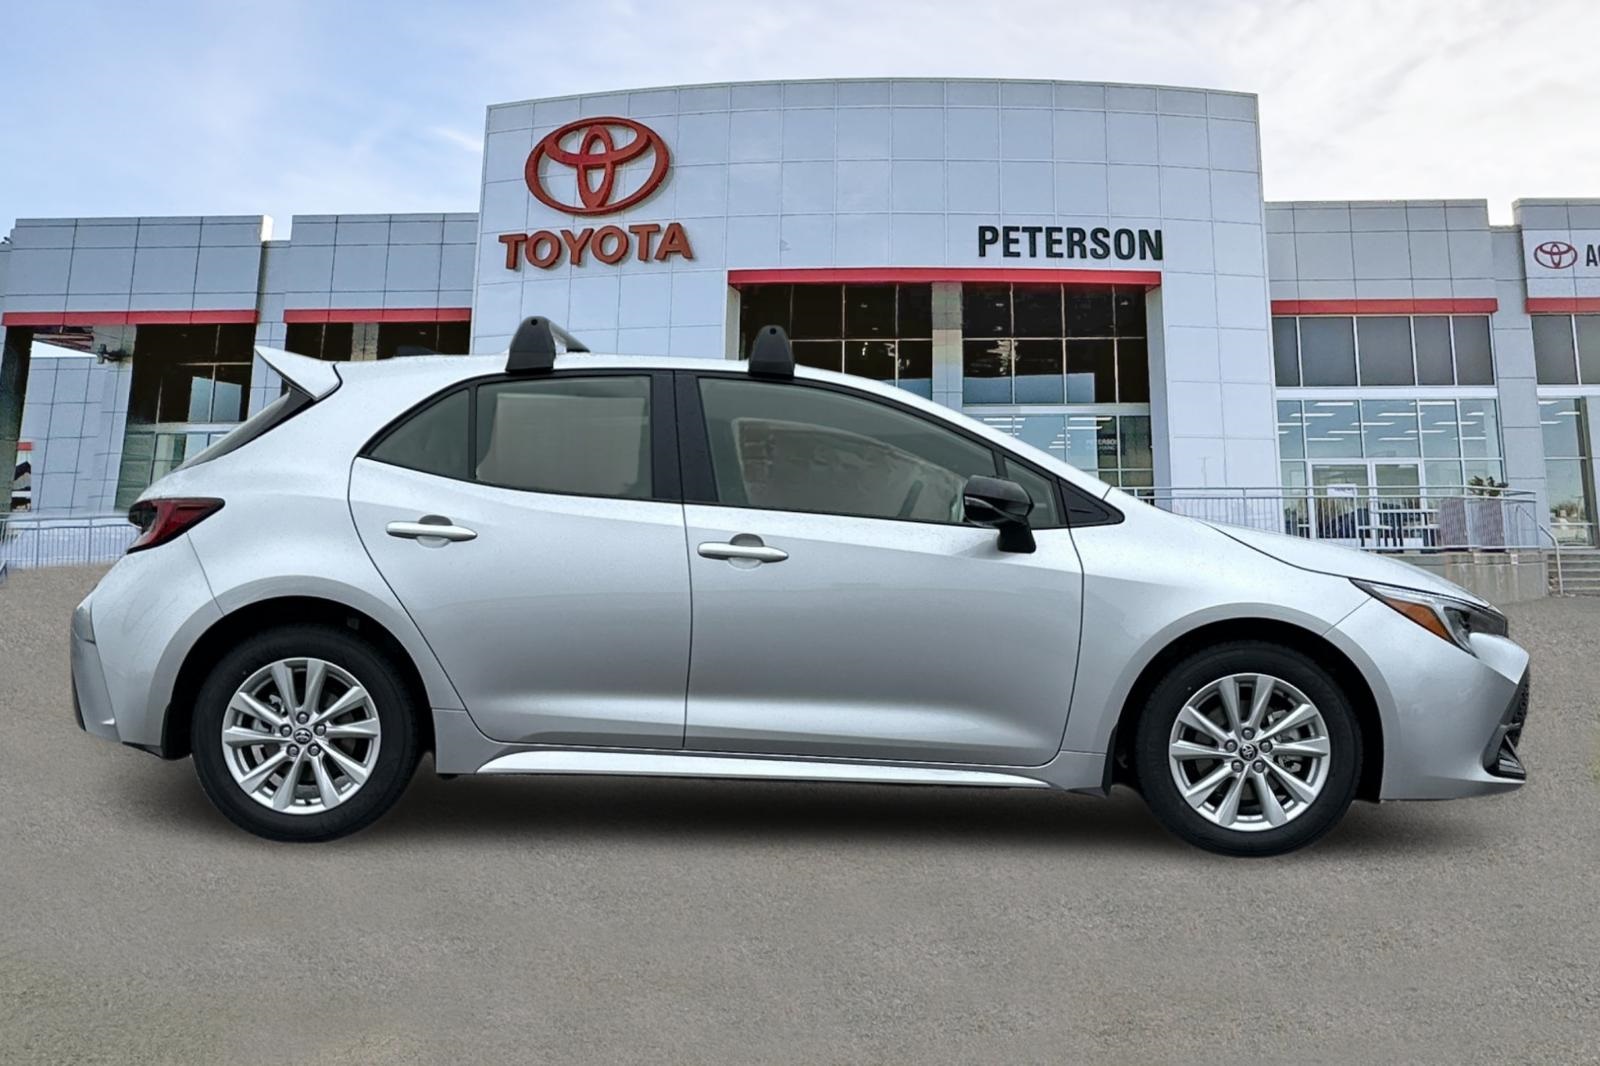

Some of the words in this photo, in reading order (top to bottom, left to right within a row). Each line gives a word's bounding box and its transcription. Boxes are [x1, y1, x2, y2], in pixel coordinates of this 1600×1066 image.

[498, 223, 694, 270] TOYOTA
[978, 226, 1164, 261] PETERSON
[1586, 244, 1600, 267] A
